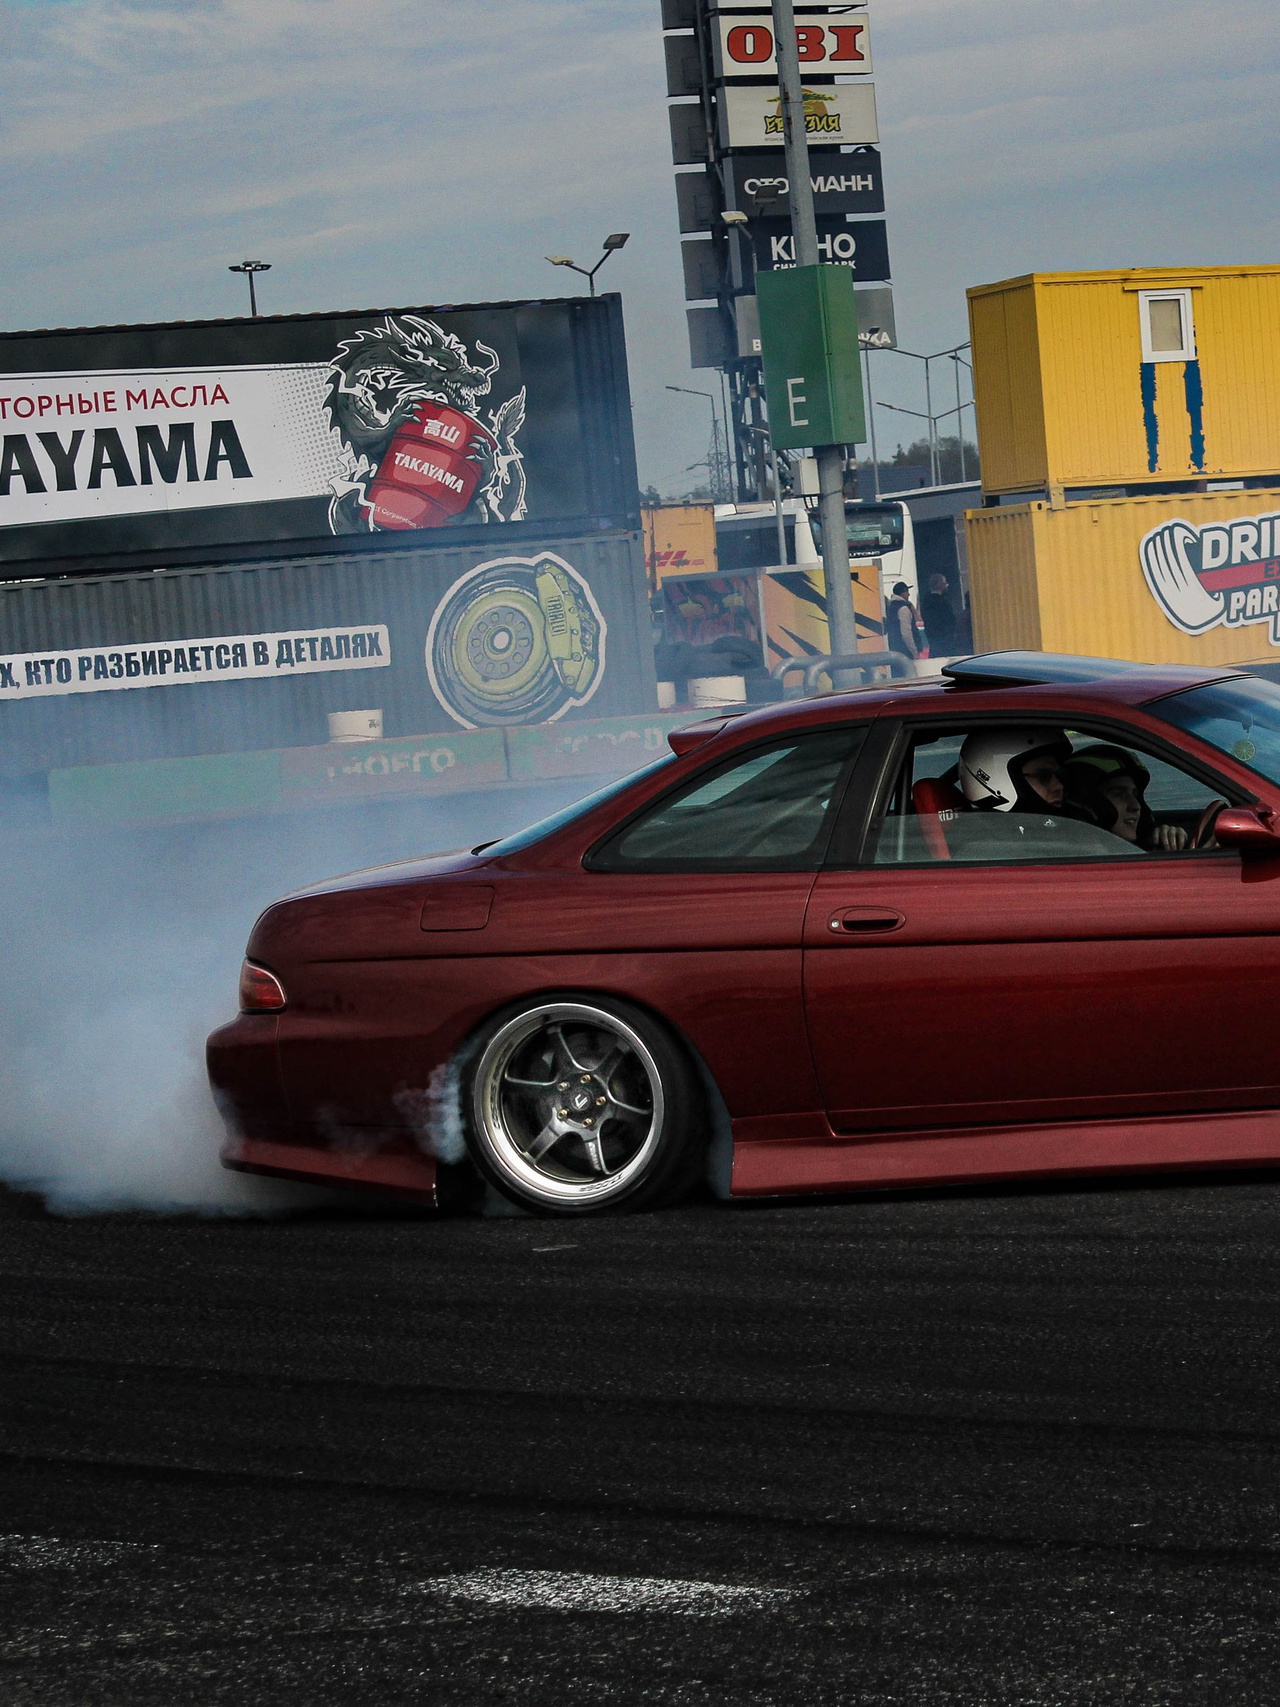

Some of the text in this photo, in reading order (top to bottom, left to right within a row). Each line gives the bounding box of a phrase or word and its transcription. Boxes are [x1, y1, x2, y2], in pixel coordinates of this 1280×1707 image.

[764, 113, 841, 134] ЕВЗИЯ
[770, 233, 856, 261] КНО
[125, 384, 230, 410] МАСЛА
[786, 378, 808, 427] E
[423, 418, 460, 443] 高山
[0, 420, 253, 495] AYAMA
[394, 452, 464, 493] TAKAYAMA
[25, 658, 72, 686] КТО
[78, 643, 247, 681] РАЗБИРАЕТСЯ
[252, 641, 270, 666] В
[275, 632, 383, 668] ДЕТАЛЯХ
